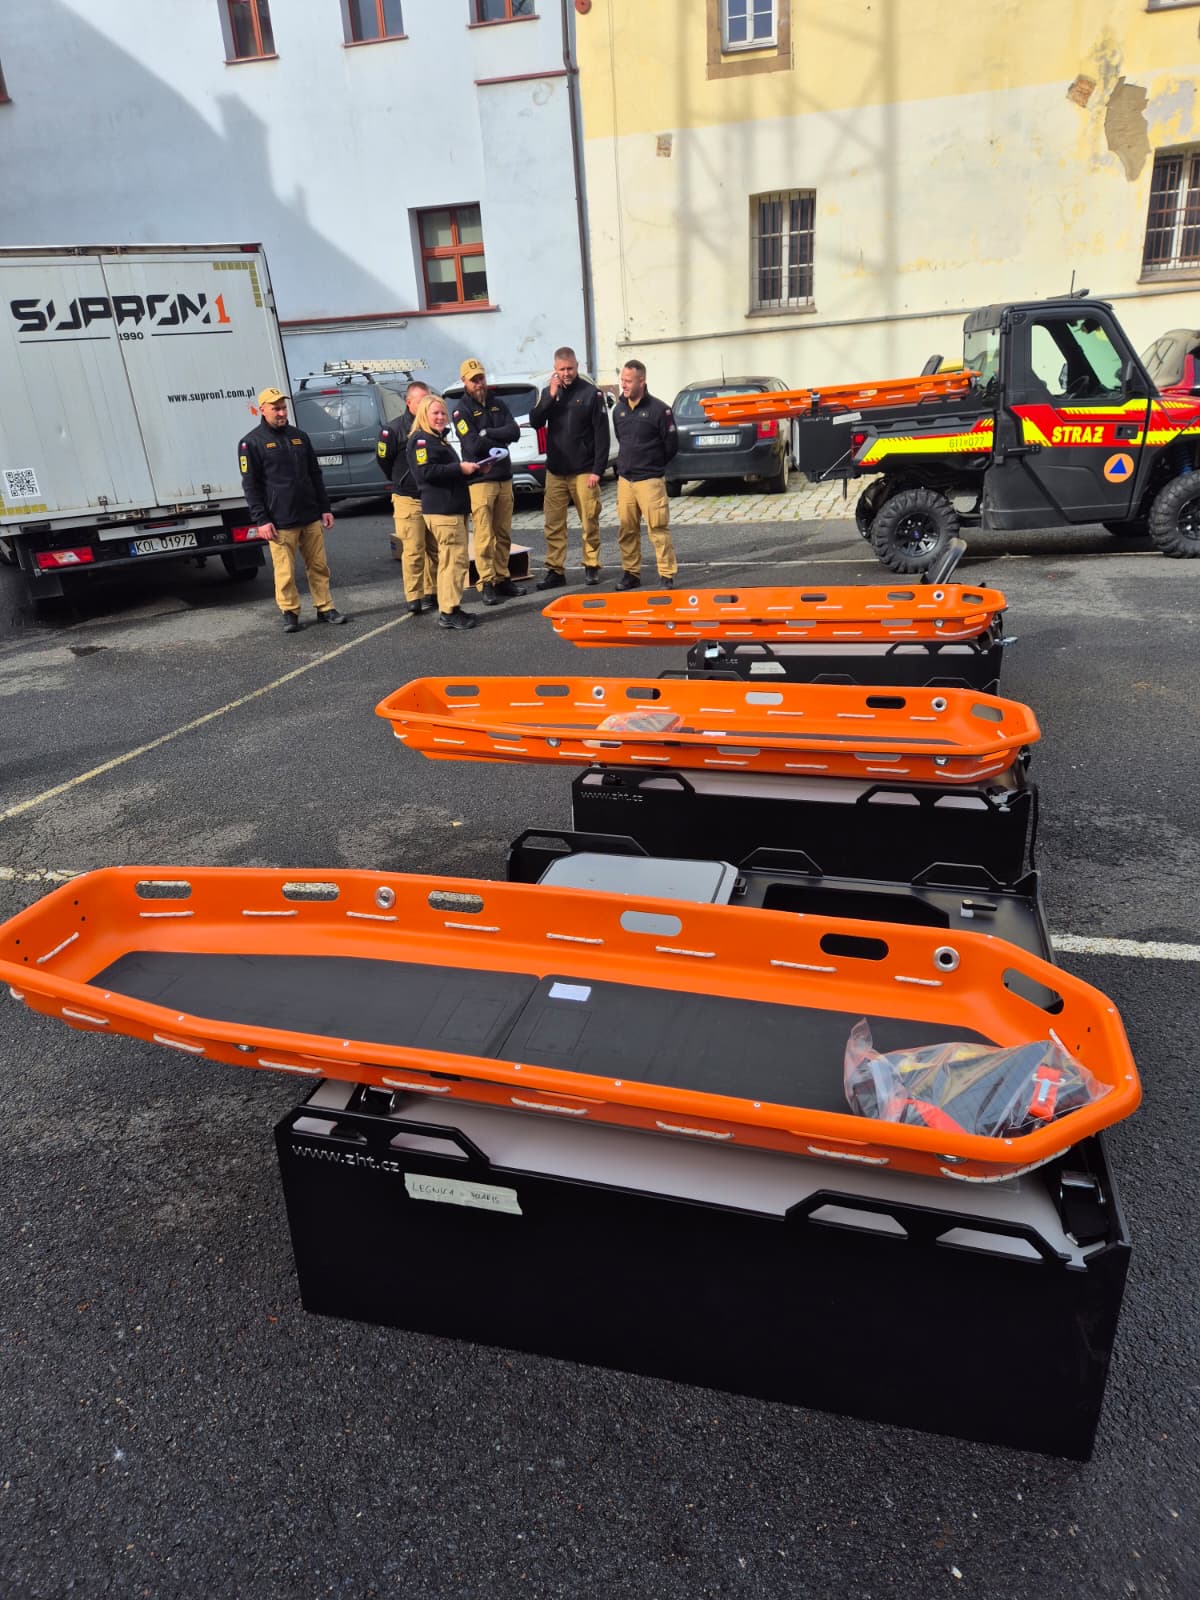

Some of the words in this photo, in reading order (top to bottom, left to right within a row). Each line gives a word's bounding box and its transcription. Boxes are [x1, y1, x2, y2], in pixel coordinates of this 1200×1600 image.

[118, 332, 144, 341] 1990
[167, 387, 256, 403] www.supron1.com.pl
[135, 540, 159, 553] KOL
[291, 1144, 400, 1173] www.zht.cz
